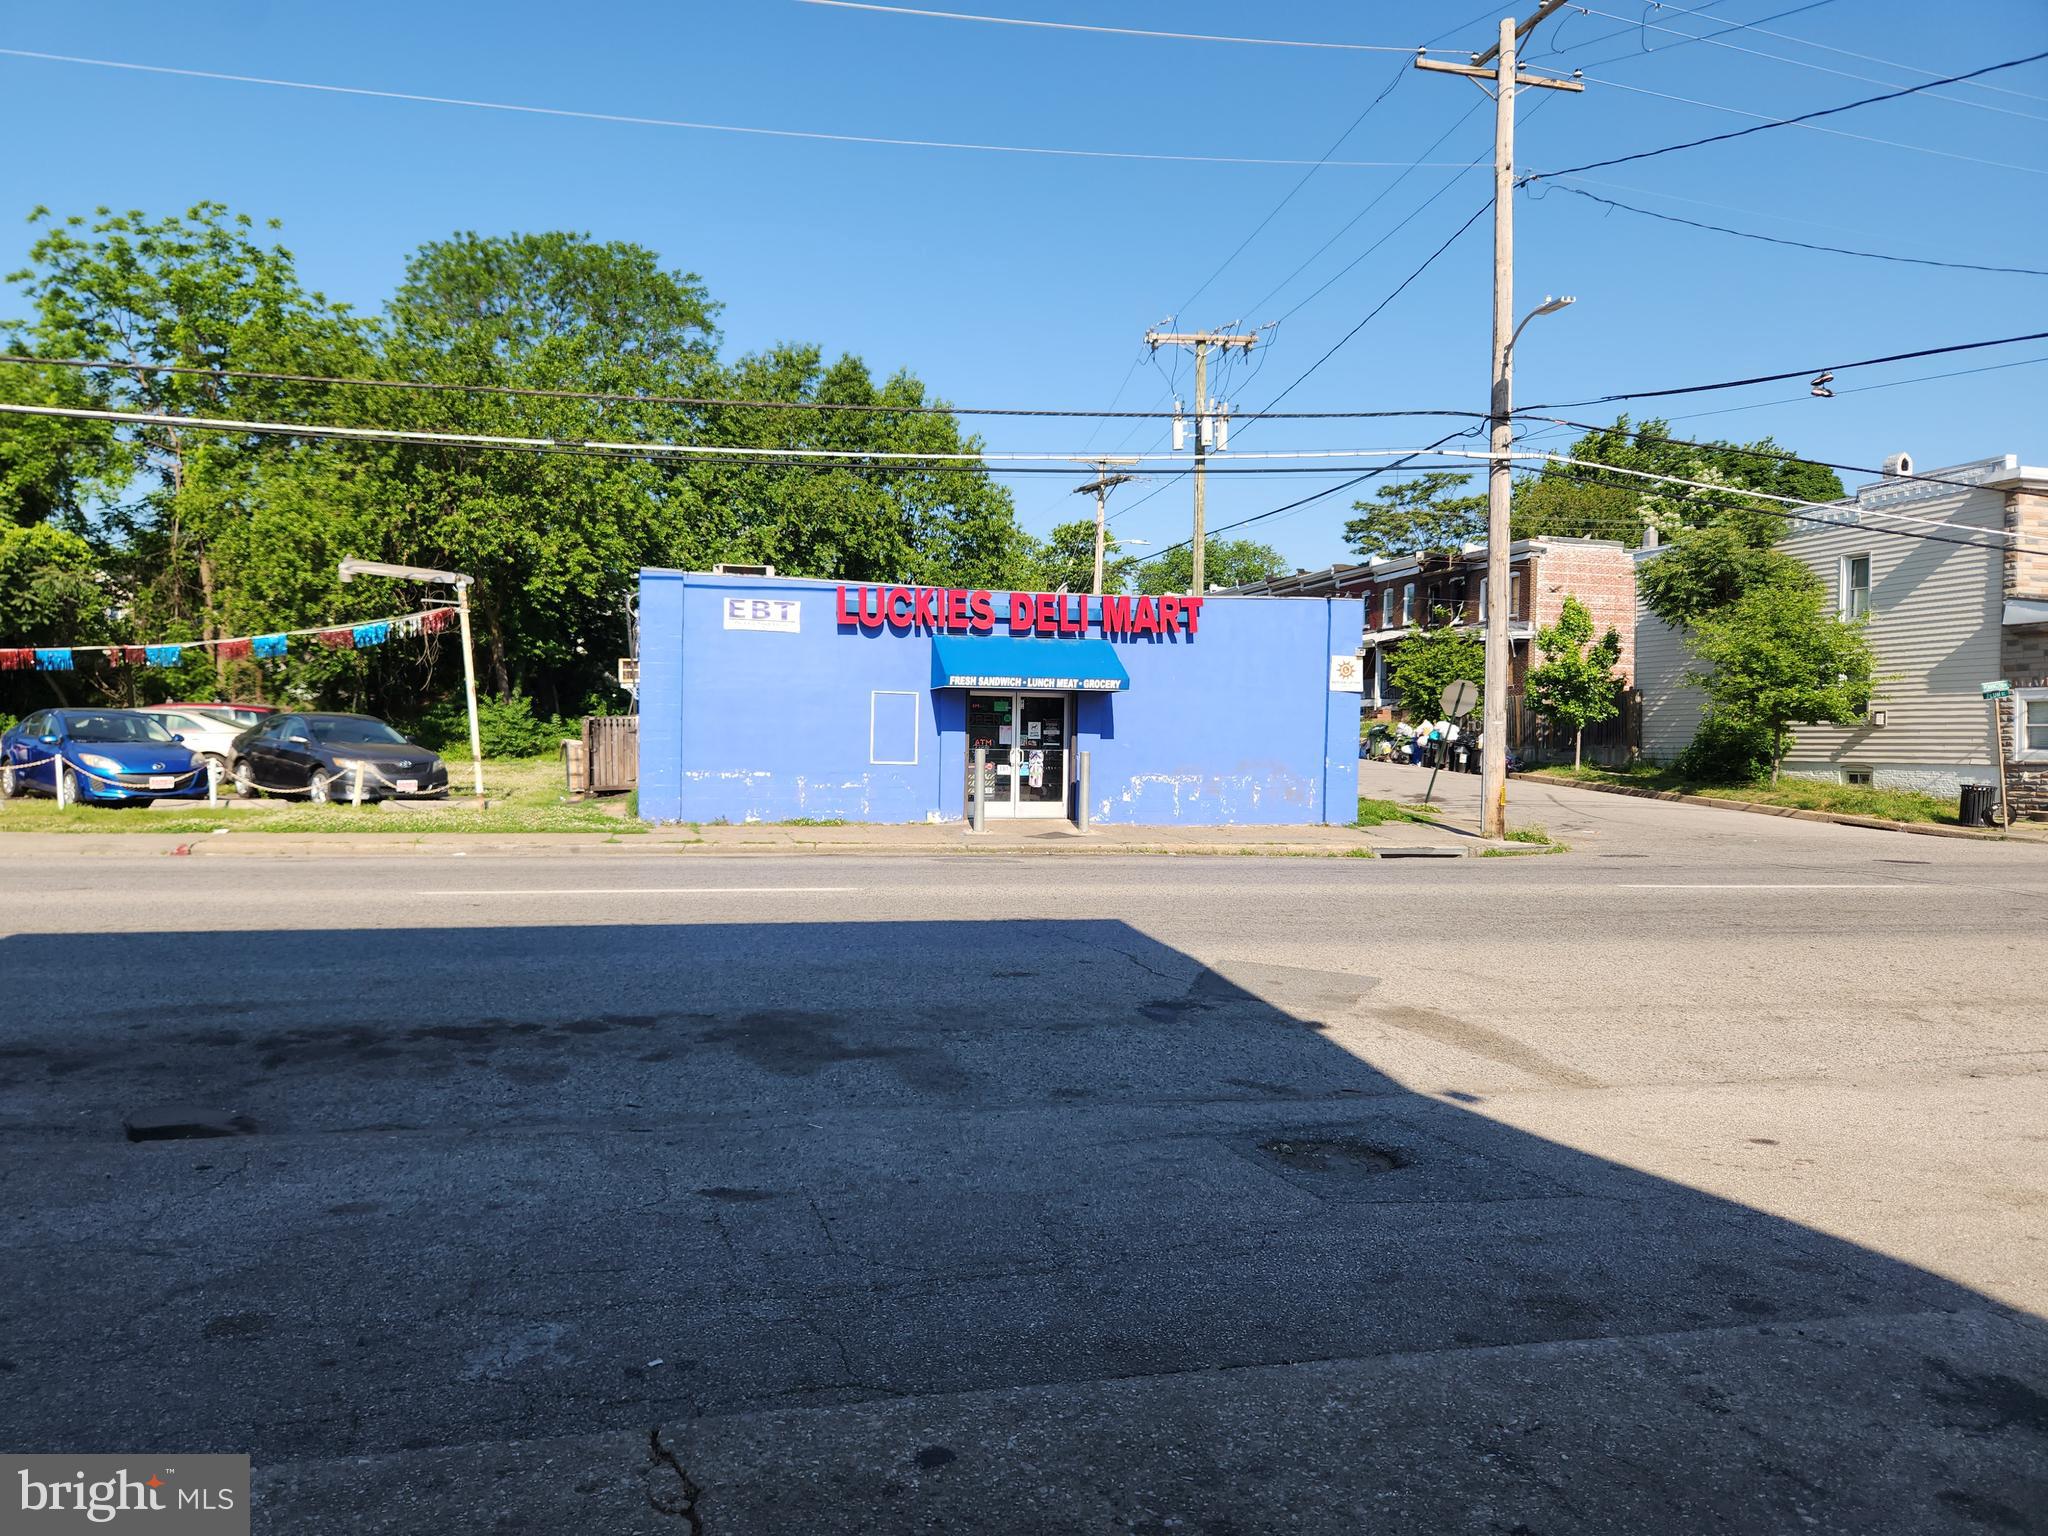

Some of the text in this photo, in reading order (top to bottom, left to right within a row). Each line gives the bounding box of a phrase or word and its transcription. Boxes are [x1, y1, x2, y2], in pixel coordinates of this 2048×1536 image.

[728, 599, 796, 621] EBT
[836, 586, 1204, 634] LUCKIES DELI MART
[949, 675, 1121, 689] FRESH SANDWICH LUNCH MEAT GROCERY
[974, 738, 993, 747] ATM
